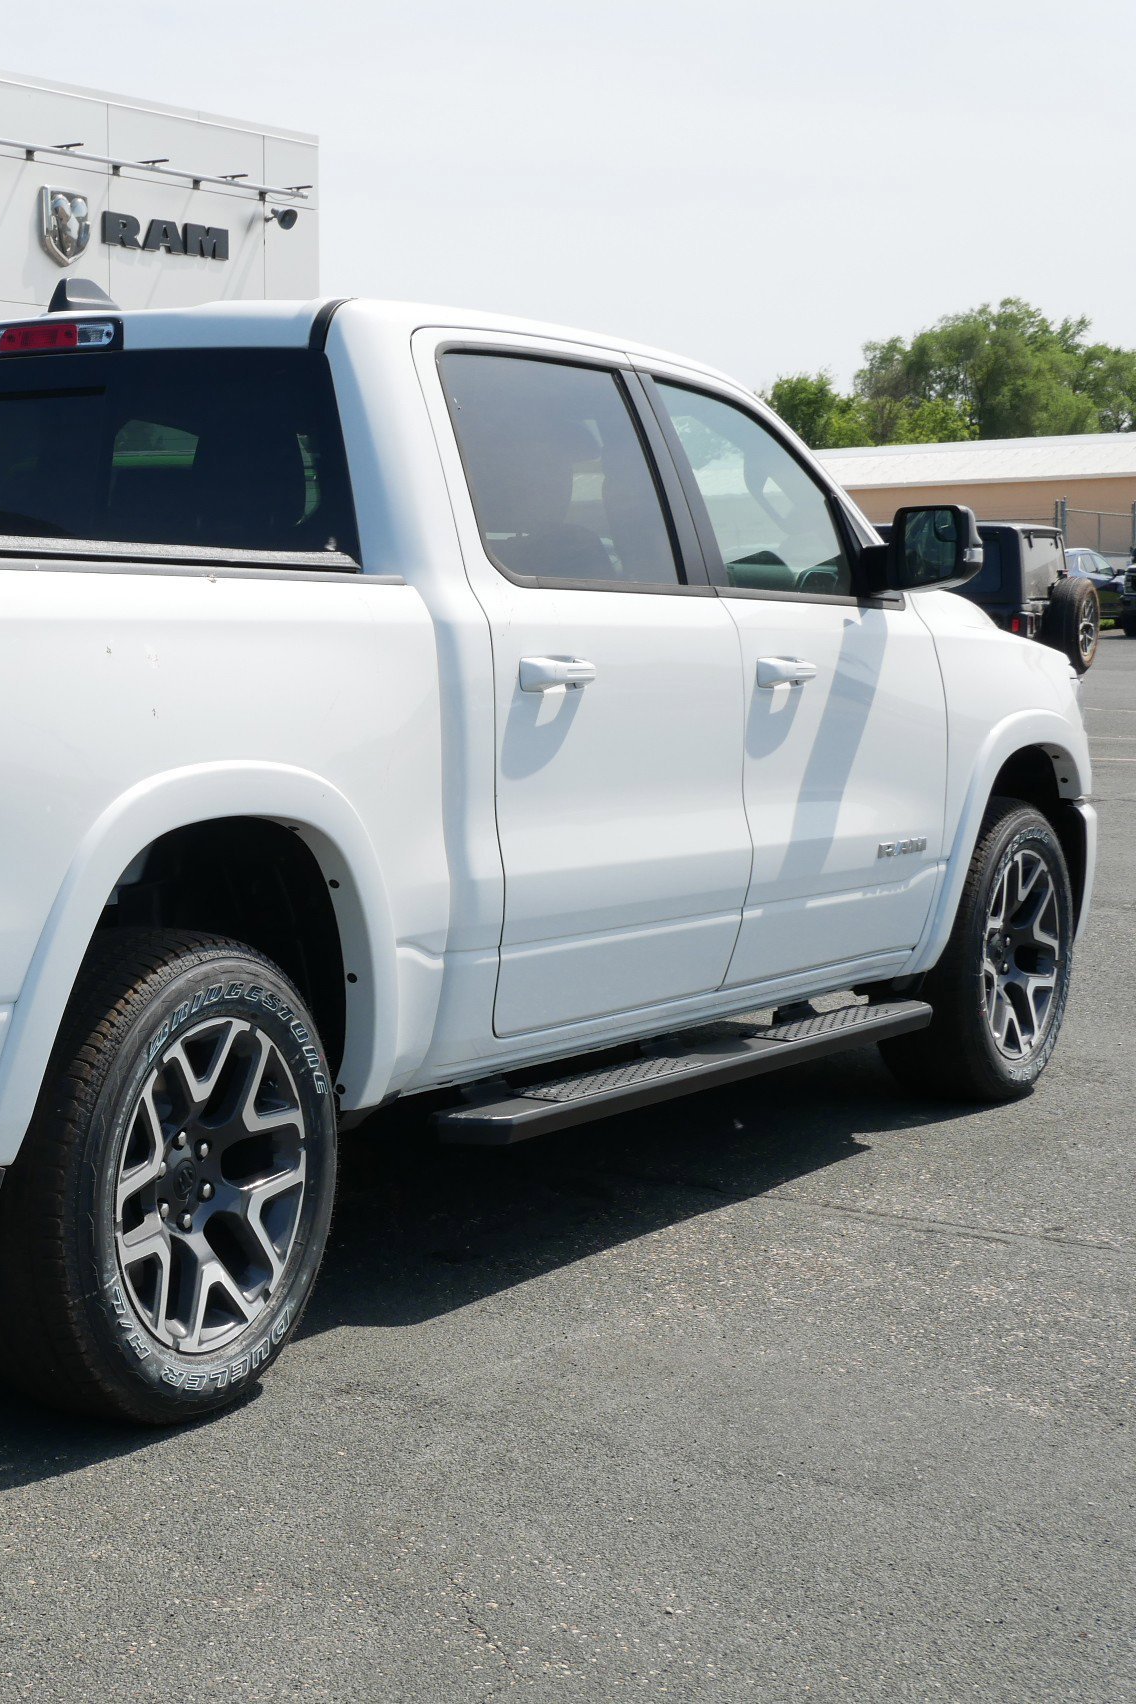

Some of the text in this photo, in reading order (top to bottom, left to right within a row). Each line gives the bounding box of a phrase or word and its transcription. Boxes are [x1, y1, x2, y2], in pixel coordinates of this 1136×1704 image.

[101, 210, 229, 261] RAM
[877, 837, 927, 859] RAM
[148, 980, 329, 1095] BRIDGESTONE
[112, 1287, 291, 1391] DUELER H/L
